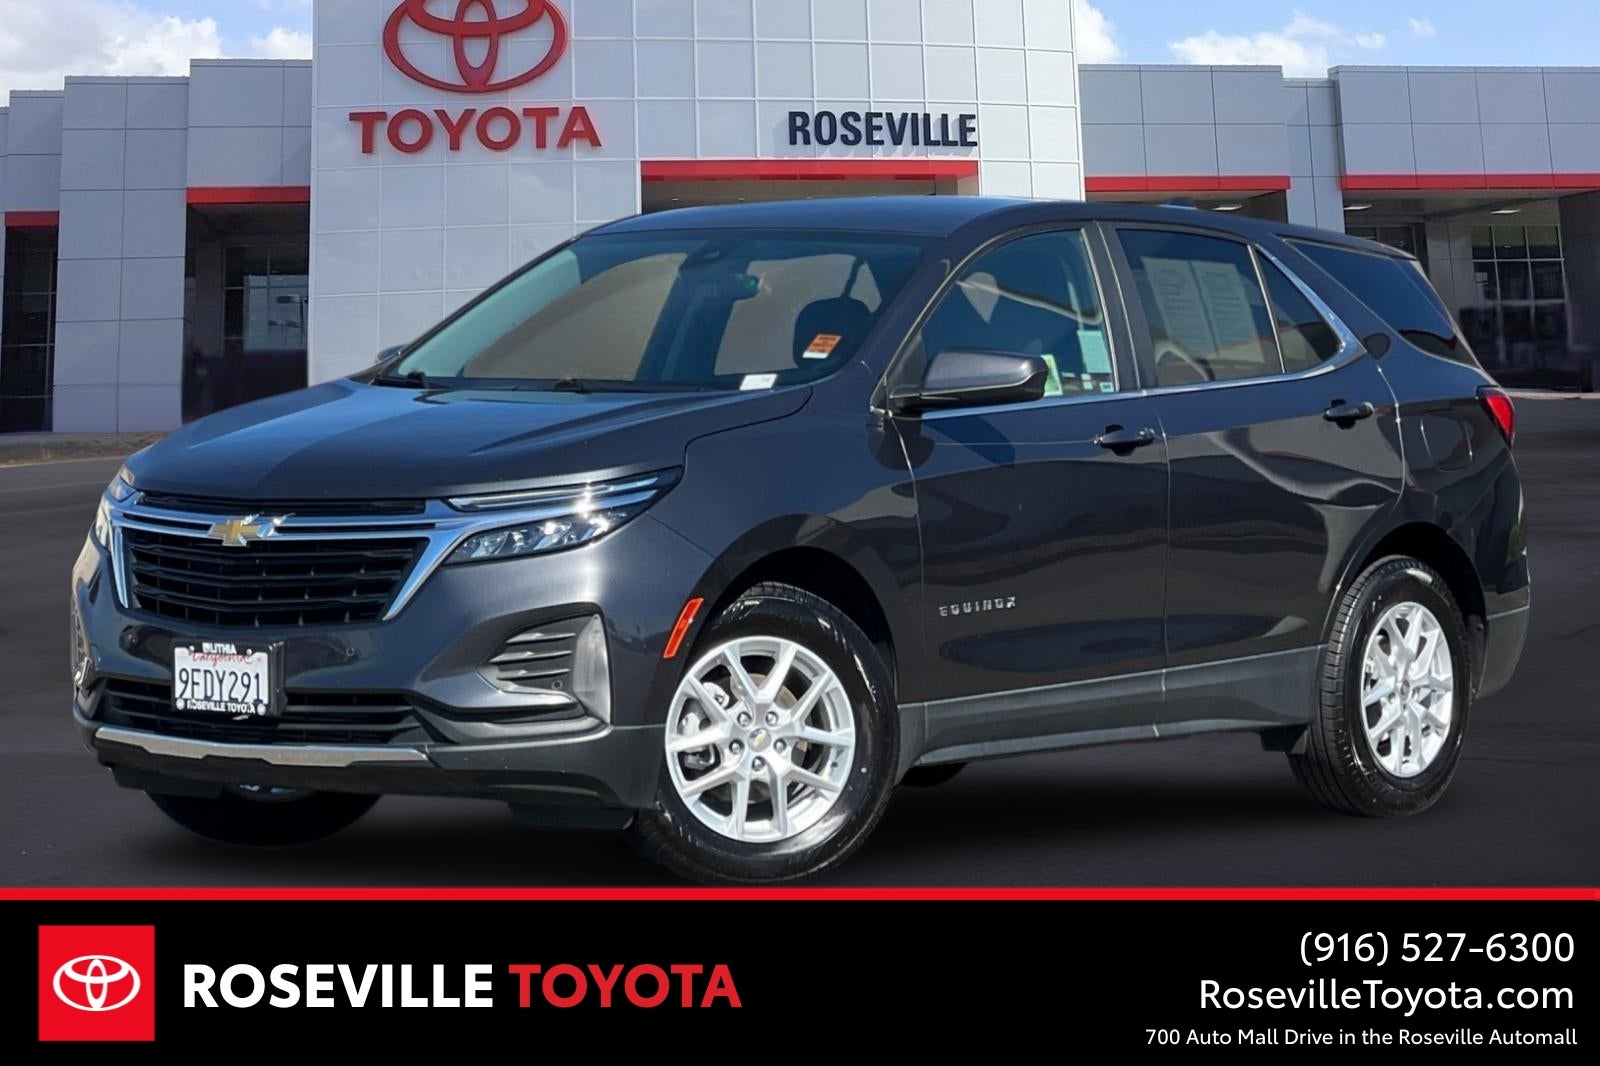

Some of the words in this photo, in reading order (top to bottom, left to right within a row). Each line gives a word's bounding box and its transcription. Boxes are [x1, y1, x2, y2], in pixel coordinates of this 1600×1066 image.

[349, 106, 602, 154] TOYOTA
[788, 110, 978, 147] ROSEVILLE
[939, 596, 1016, 617] EQUINOX
[179, 667, 263, 704] 9FDY291
[187, 699, 226, 712] ROSEVILLE
